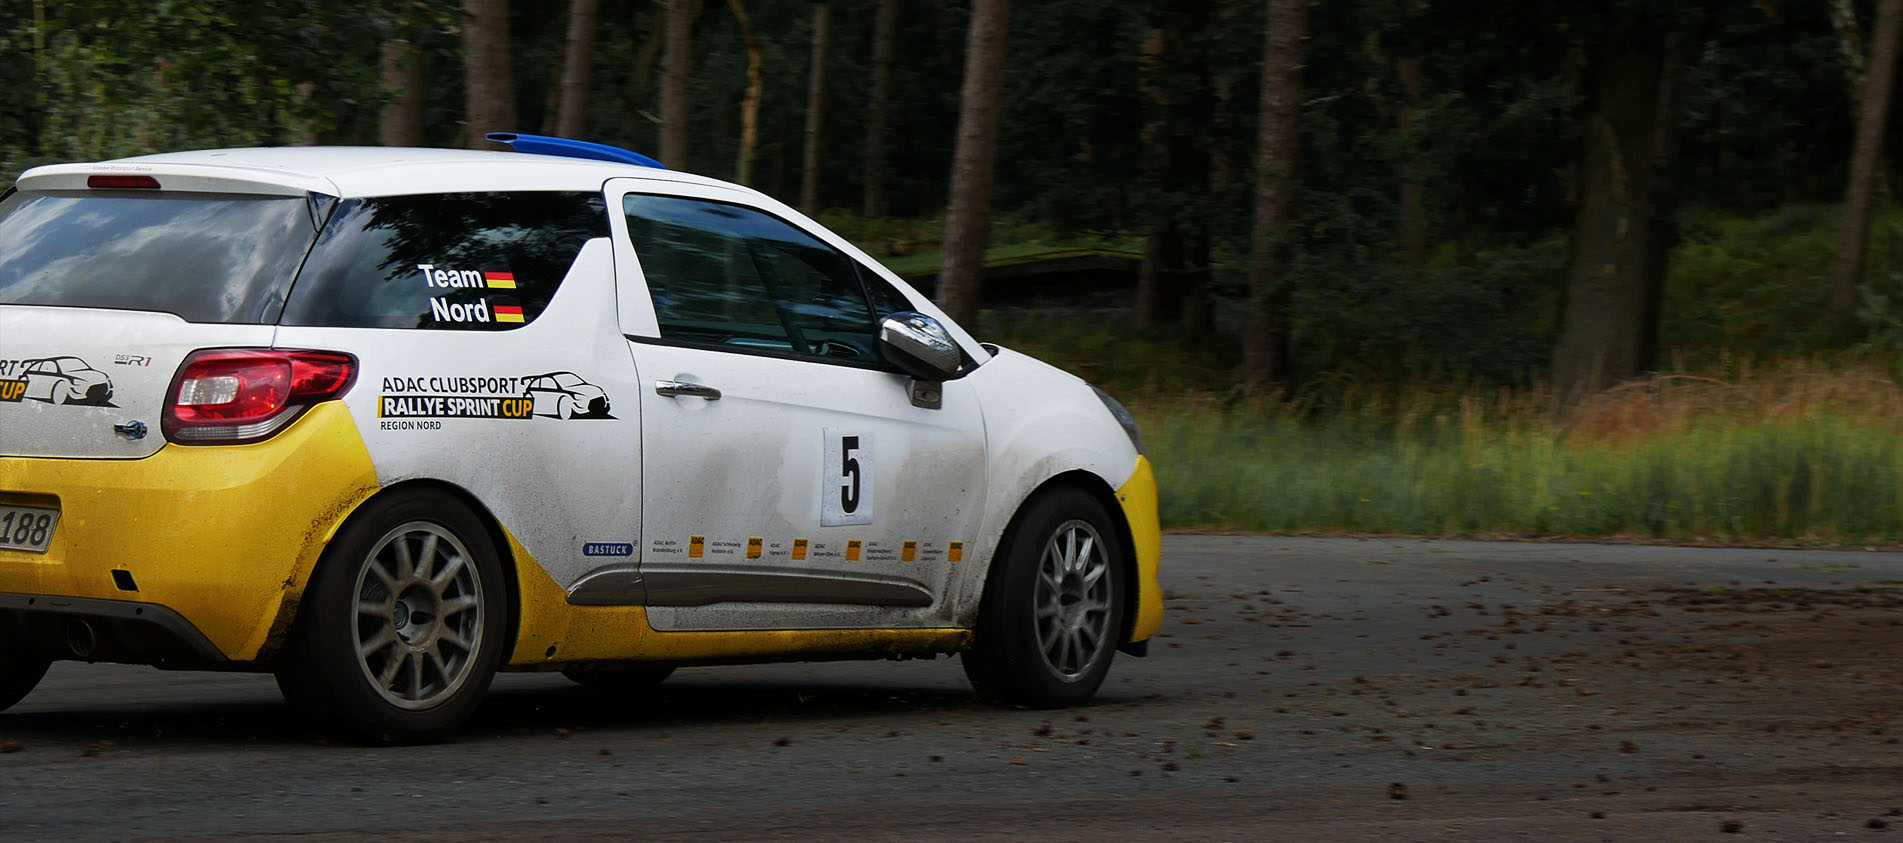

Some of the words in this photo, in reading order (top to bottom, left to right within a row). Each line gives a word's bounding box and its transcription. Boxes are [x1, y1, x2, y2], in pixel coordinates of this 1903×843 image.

[417, 263, 484, 288] Team
[429, 297, 491, 323] Nord
[0, 381, 26, 400] UP
[382, 377, 428, 393] ADAC
[429, 377, 519, 394] CLUBSPORT
[384, 397, 445, 416] RALLYE
[447, 398, 501, 417] SPRINT
[502, 399, 533, 417] CUP
[380, 421, 415, 430] REGION
[416, 421, 442, 430] NORD
[841, 435, 860, 514] 5
[0, 511, 51, 546] 188
[588, 545, 628, 554] BASTUCK
